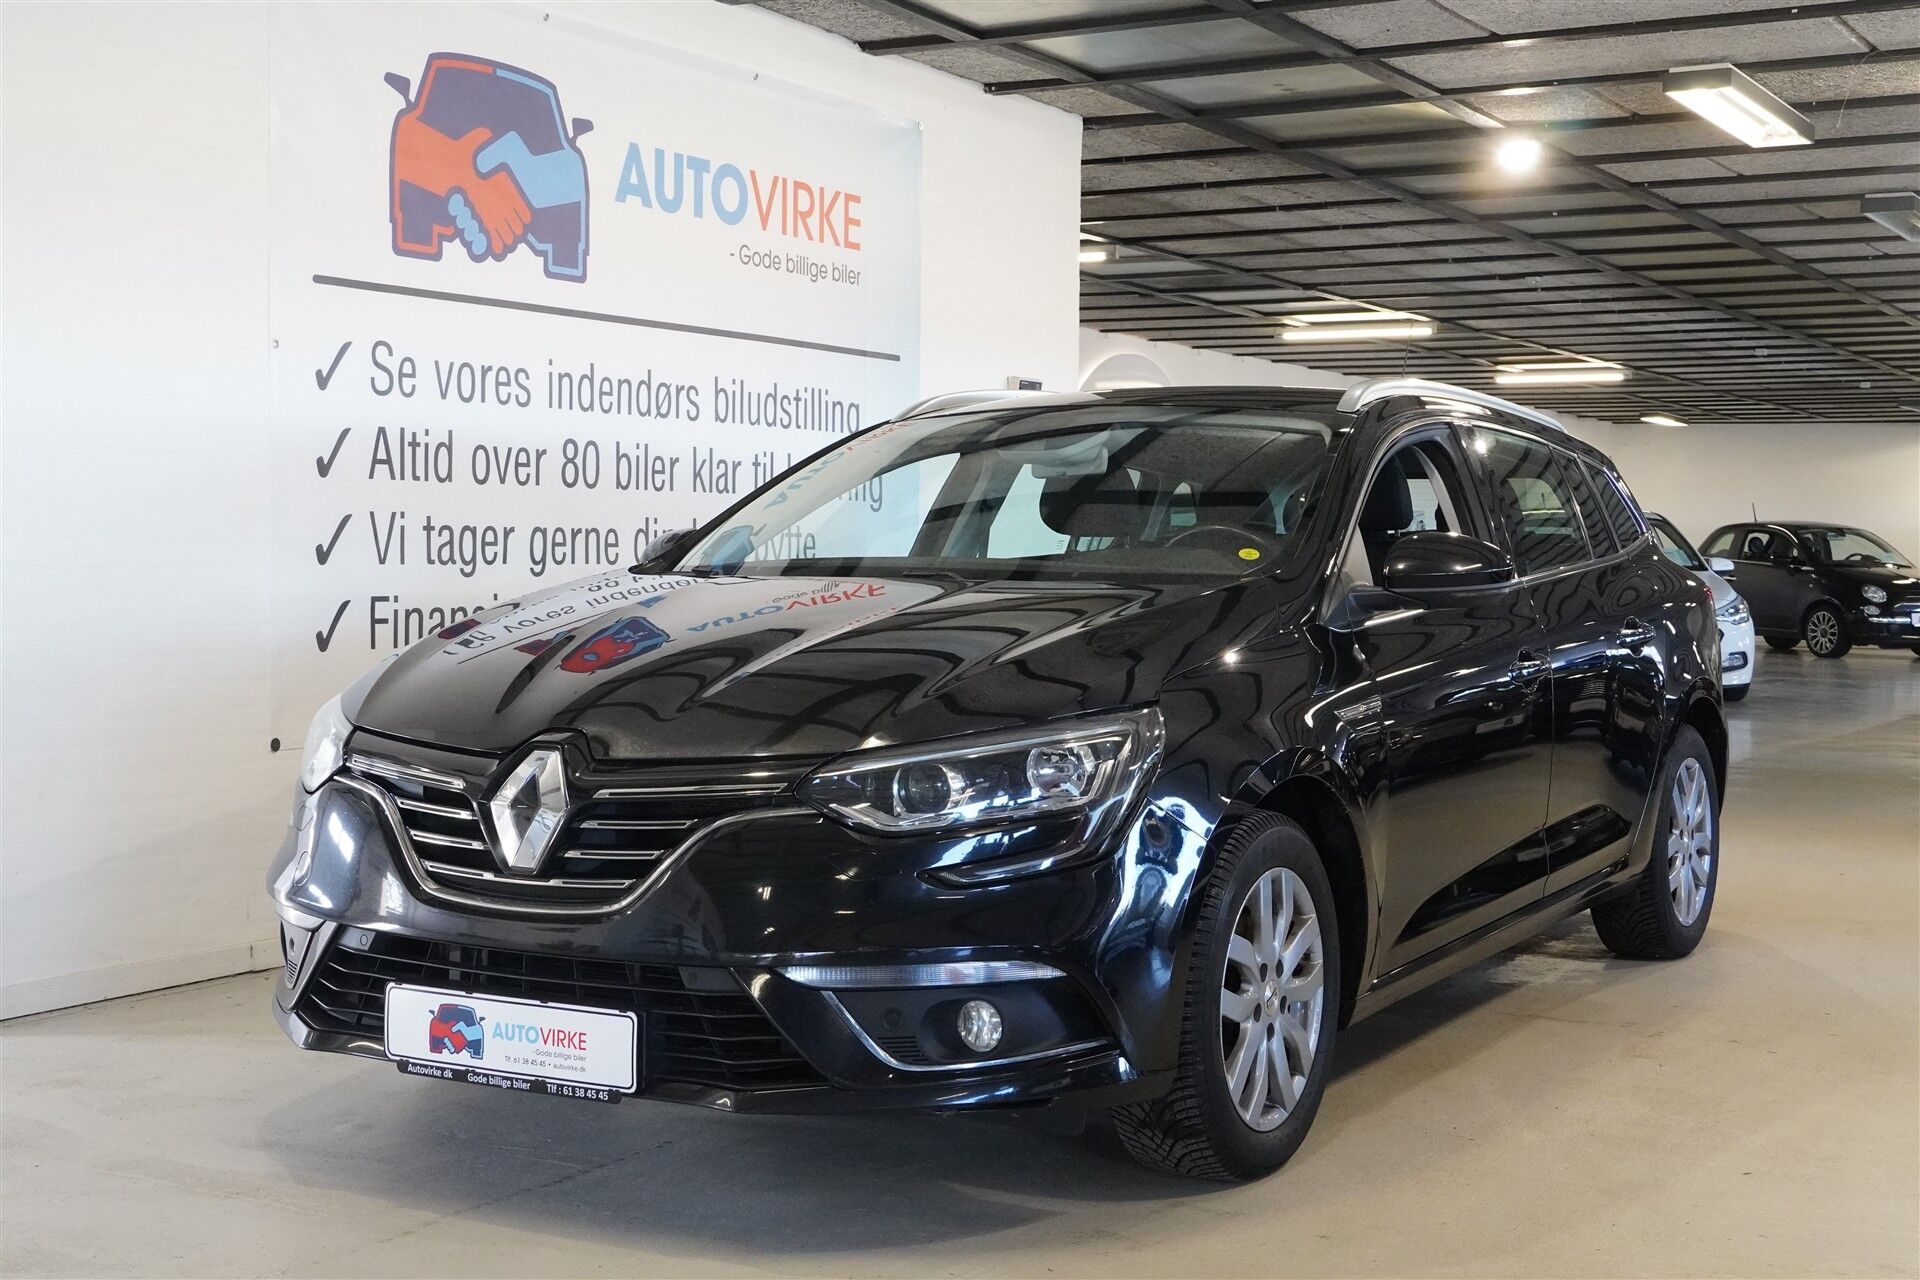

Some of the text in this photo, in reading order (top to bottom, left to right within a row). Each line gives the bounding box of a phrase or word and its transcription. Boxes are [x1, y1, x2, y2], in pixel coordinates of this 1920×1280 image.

[615, 142, 861, 251] AUTOVIRKE
[739, 244, 782, 271] Gode
[786, 253, 828, 282] billige
[832, 262, 861, 286] biler
[370, 340, 860, 433] Se vores indendørs biludstilling
[368, 426, 453, 484] Altid
[471, 443, 547, 487] over
[560, 438, 600, 489] 80
[616, 441, 680, 492] biler
[692, 446, 742, 495] klar
[369, 511, 406, 566] Vi
[422, 515, 516, 578] tager
[529, 526, 620, 578] gerne
[492, 1022, 587, 1051] AUTOVIRKE
[530, 1059, 538, 1067] 45
[539, 1060, 547, 1068] 45
[535, 1048, 553, 1058] Gode
[554, 1051, 572, 1061] billige
[573, 1054, 587, 1062] biler
[467, 1072, 531, 1090] Gode billige biler
[562, 1086, 573, 1096] 61
[574, 1088, 585, 1098] 38
[586, 1089, 597, 1100] 45
[598, 1091, 609, 1101] 45
